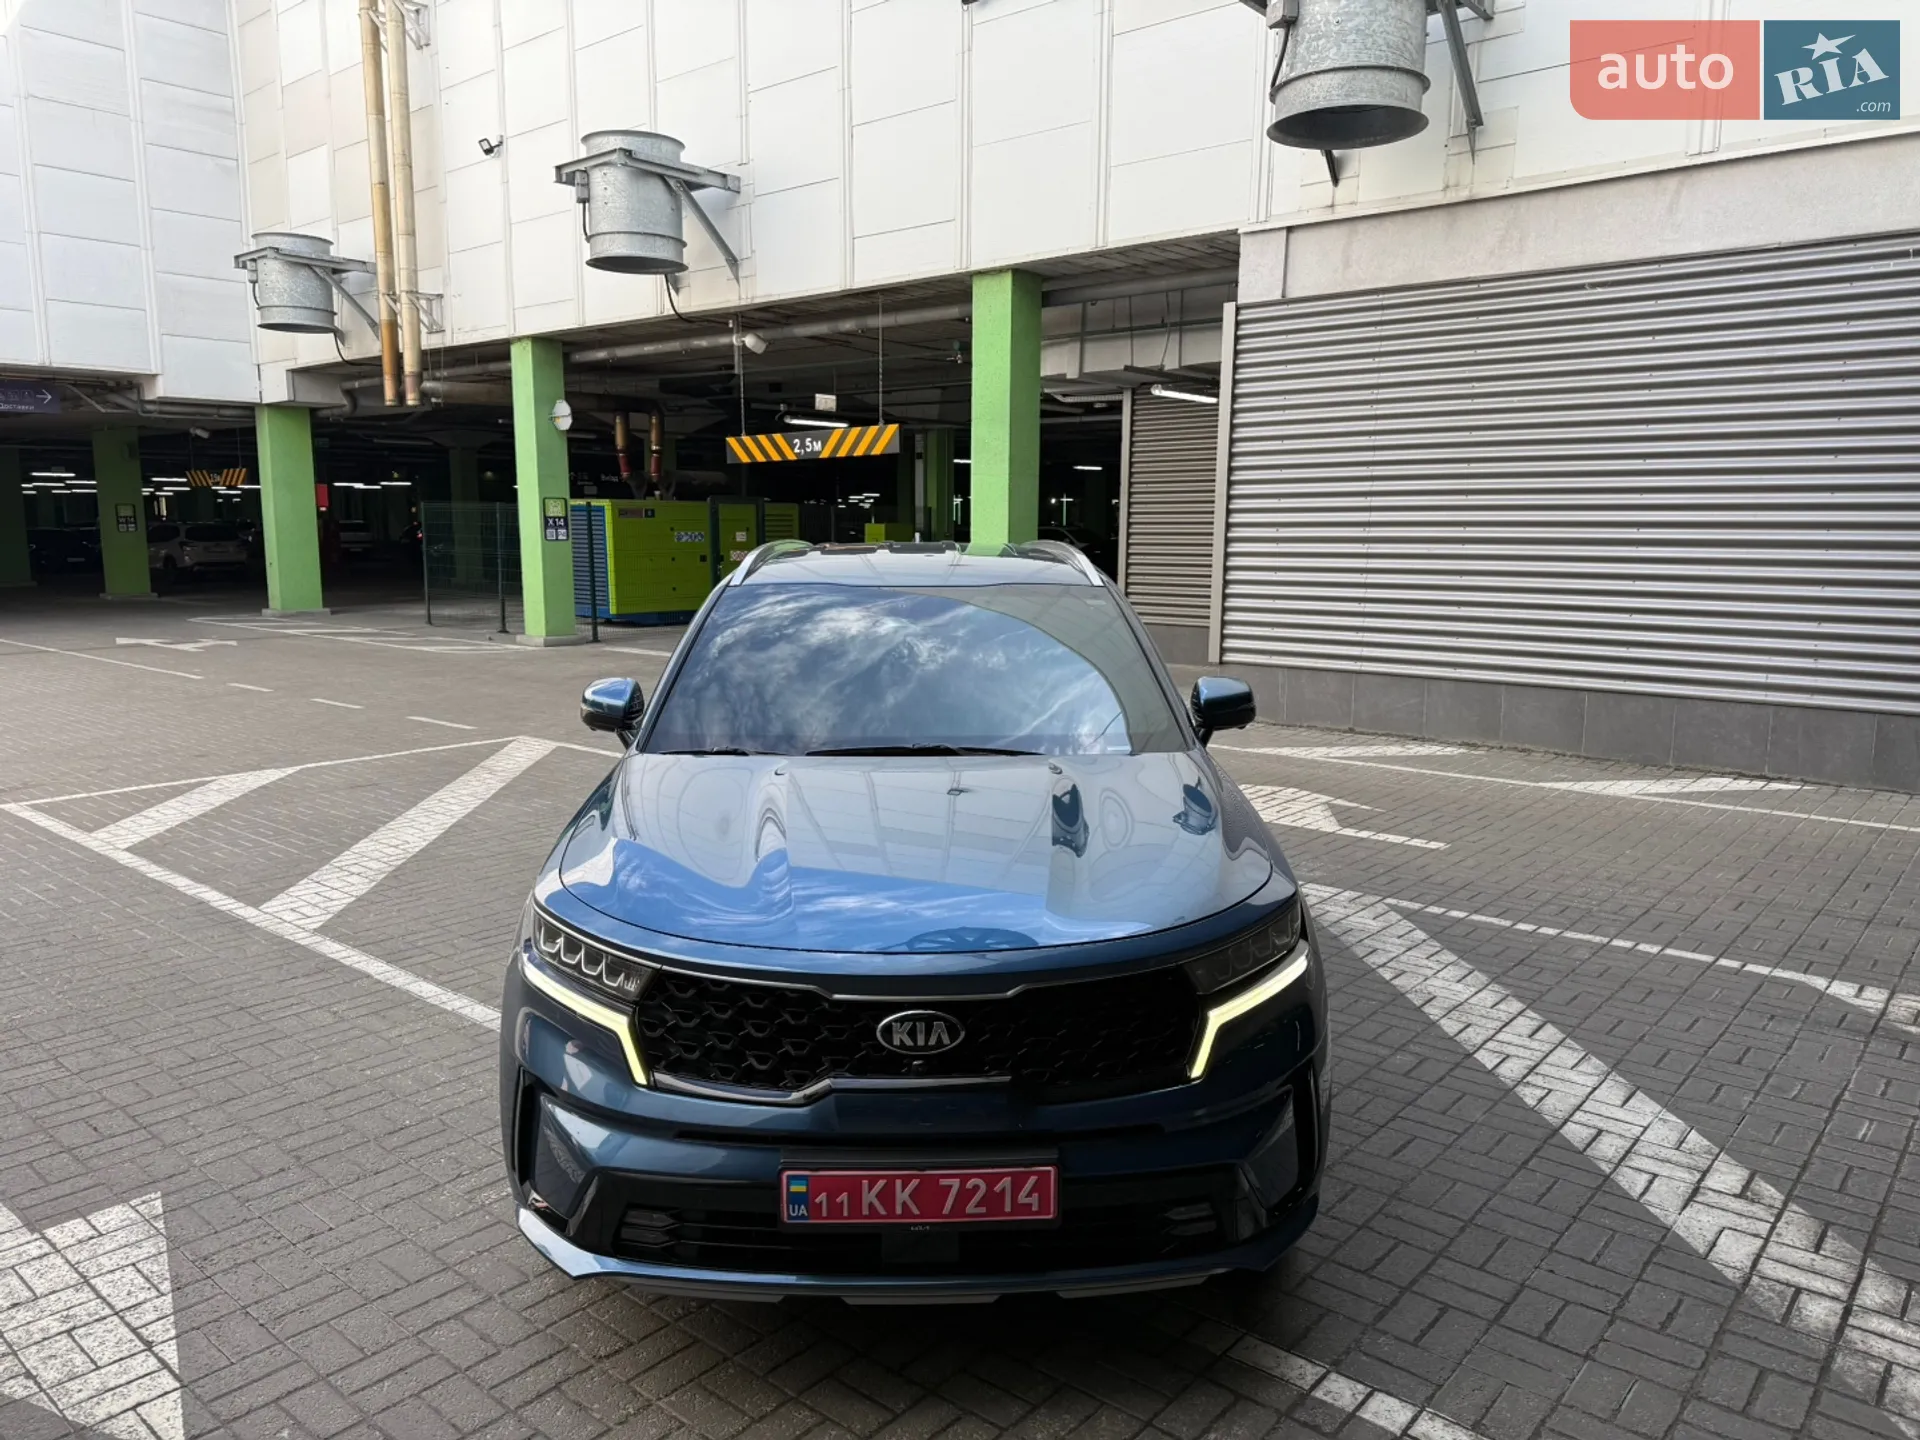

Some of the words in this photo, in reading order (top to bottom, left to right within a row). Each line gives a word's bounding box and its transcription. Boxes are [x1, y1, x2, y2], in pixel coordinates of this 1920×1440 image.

[891, 1021, 951, 1047] KIA
[938, 1175, 1040, 1215] 7214
[789, 1204, 808, 1217] UA
